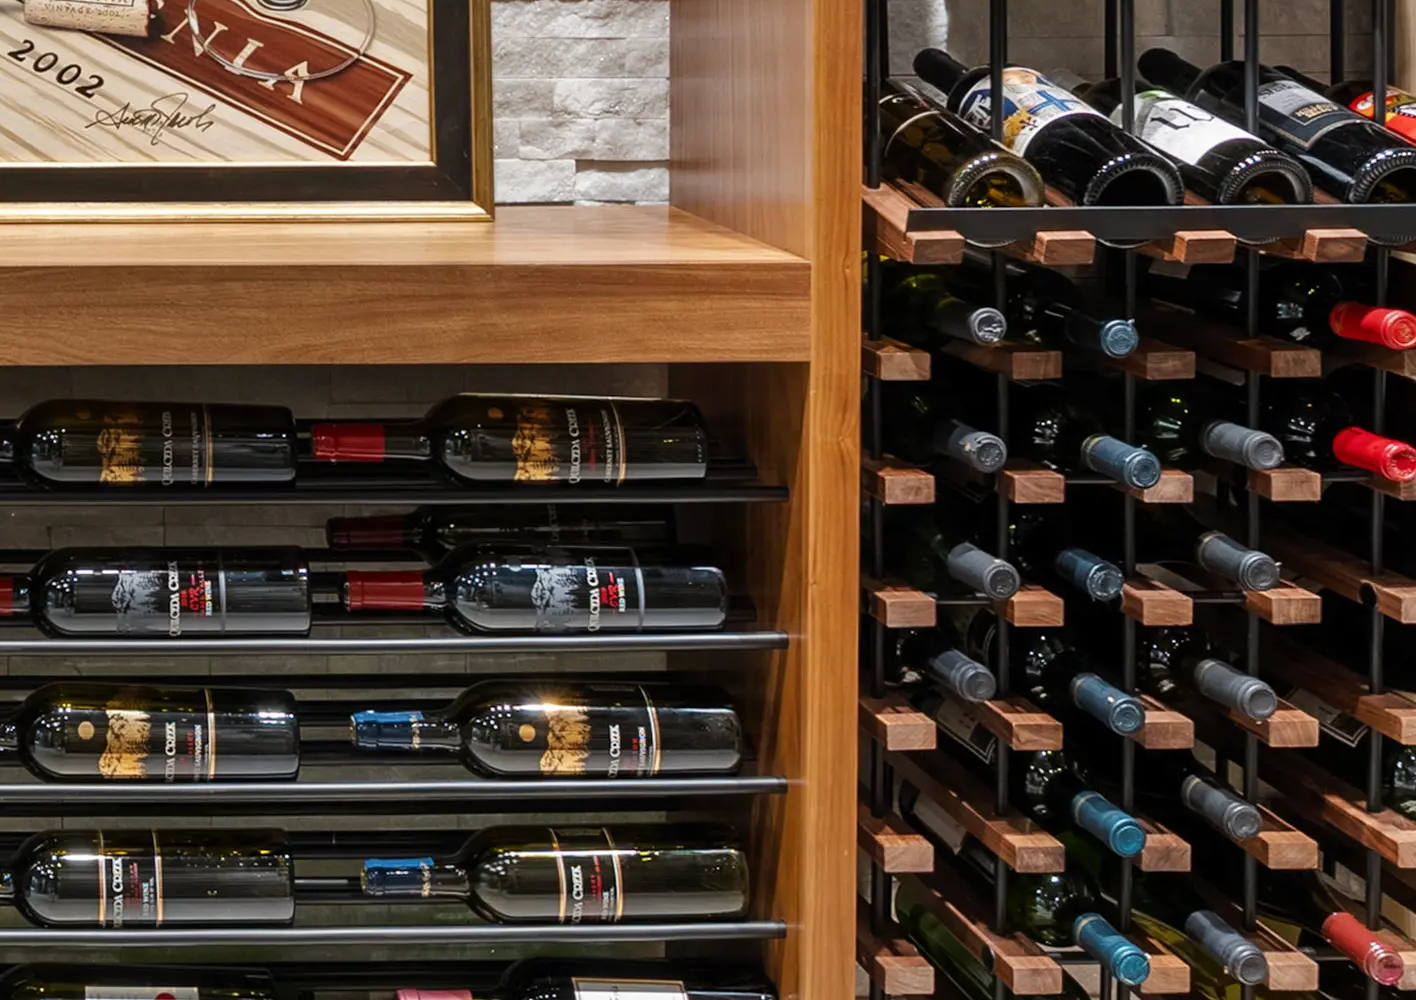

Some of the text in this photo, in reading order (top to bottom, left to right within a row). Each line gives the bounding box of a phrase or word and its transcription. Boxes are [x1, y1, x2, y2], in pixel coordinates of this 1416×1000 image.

[44, 3, 93, 15] VINTAGE
[8, 39, 105, 99] 2002
[161, 440, 174, 486] QUILCEDA
[566, 408, 581, 484] QUILCEDA CREEK
[616, 578, 625, 597] WINE
[169, 593, 182, 637] QUILCEDA
[588, 588, 601, 632] QUILCEDA
[165, 722, 176, 756] CREEK
[609, 724, 621, 758] CREEK
[112, 857, 123, 893] CREEK
[570, 865, 583, 900] CREEK
